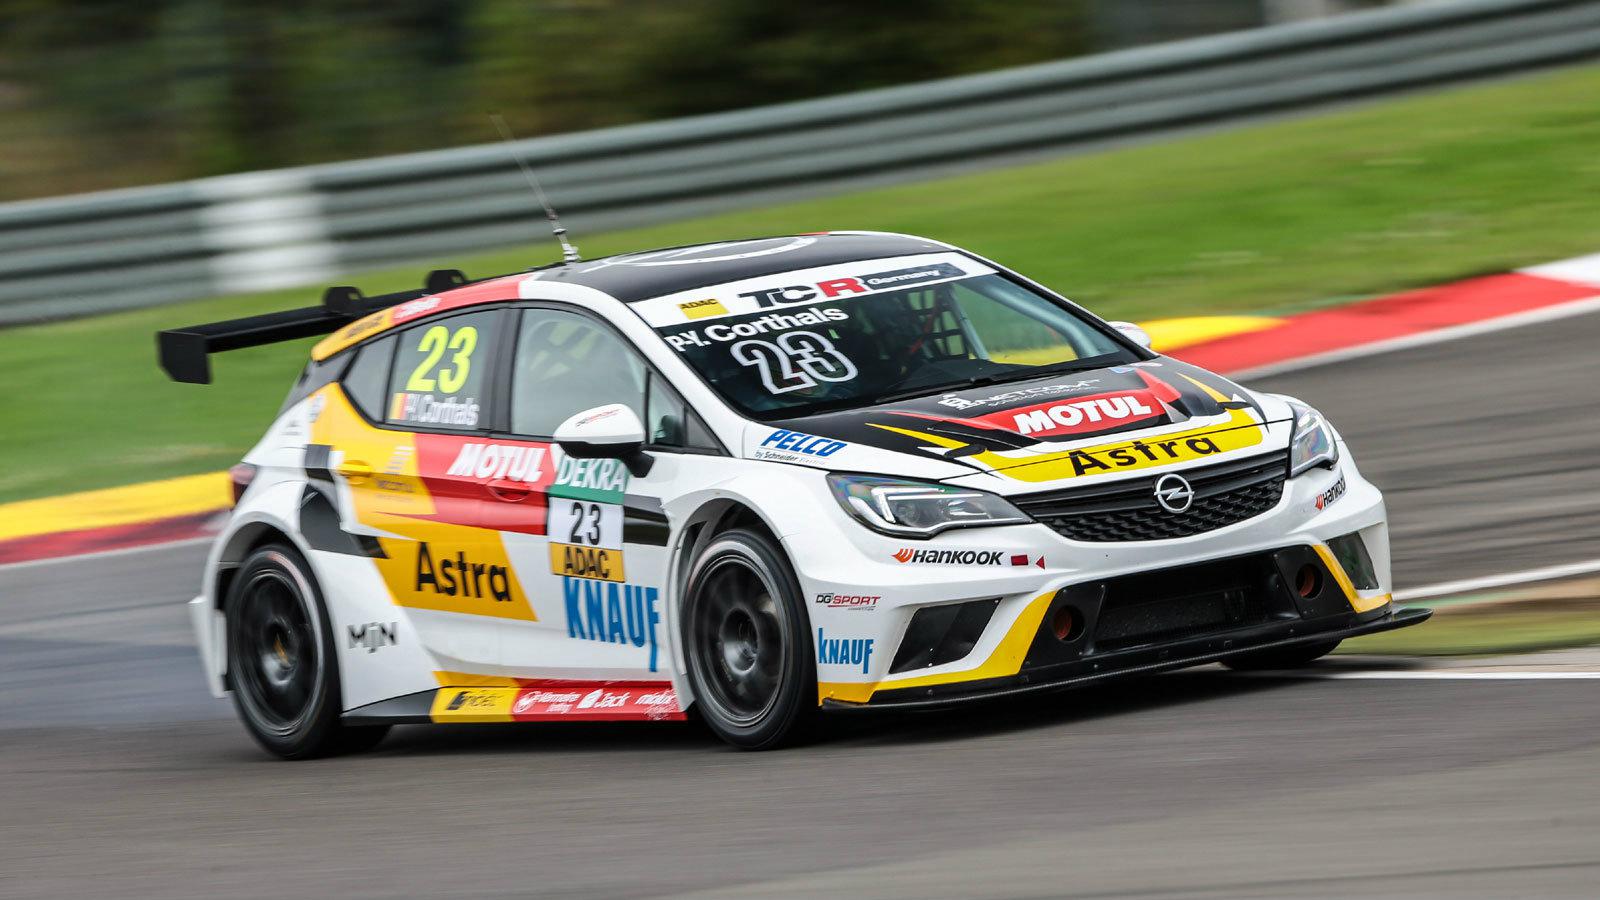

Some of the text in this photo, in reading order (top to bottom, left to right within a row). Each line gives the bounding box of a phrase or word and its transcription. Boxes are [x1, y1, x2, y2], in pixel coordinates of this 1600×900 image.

[680, 298, 718, 311] ADAC
[738, 269, 941, 309] TCR Germany
[704, 307, 849, 341] Corthals
[406, 325, 479, 394] 23
[730, 331, 859, 394] 23
[1013, 395, 1152, 435] MOTUL
[447, 443, 549, 482] MOTUL
[761, 428, 847, 457] PELCO
[764, 451, 798, 462] Schneider
[1068, 437, 1222, 477] Astra
[555, 458, 625, 492] DEKRA
[570, 502, 601, 546] 23
[415, 541, 513, 603] Astra
[564, 546, 609, 579] ADAC
[563, 575, 660, 673] KNAUF
